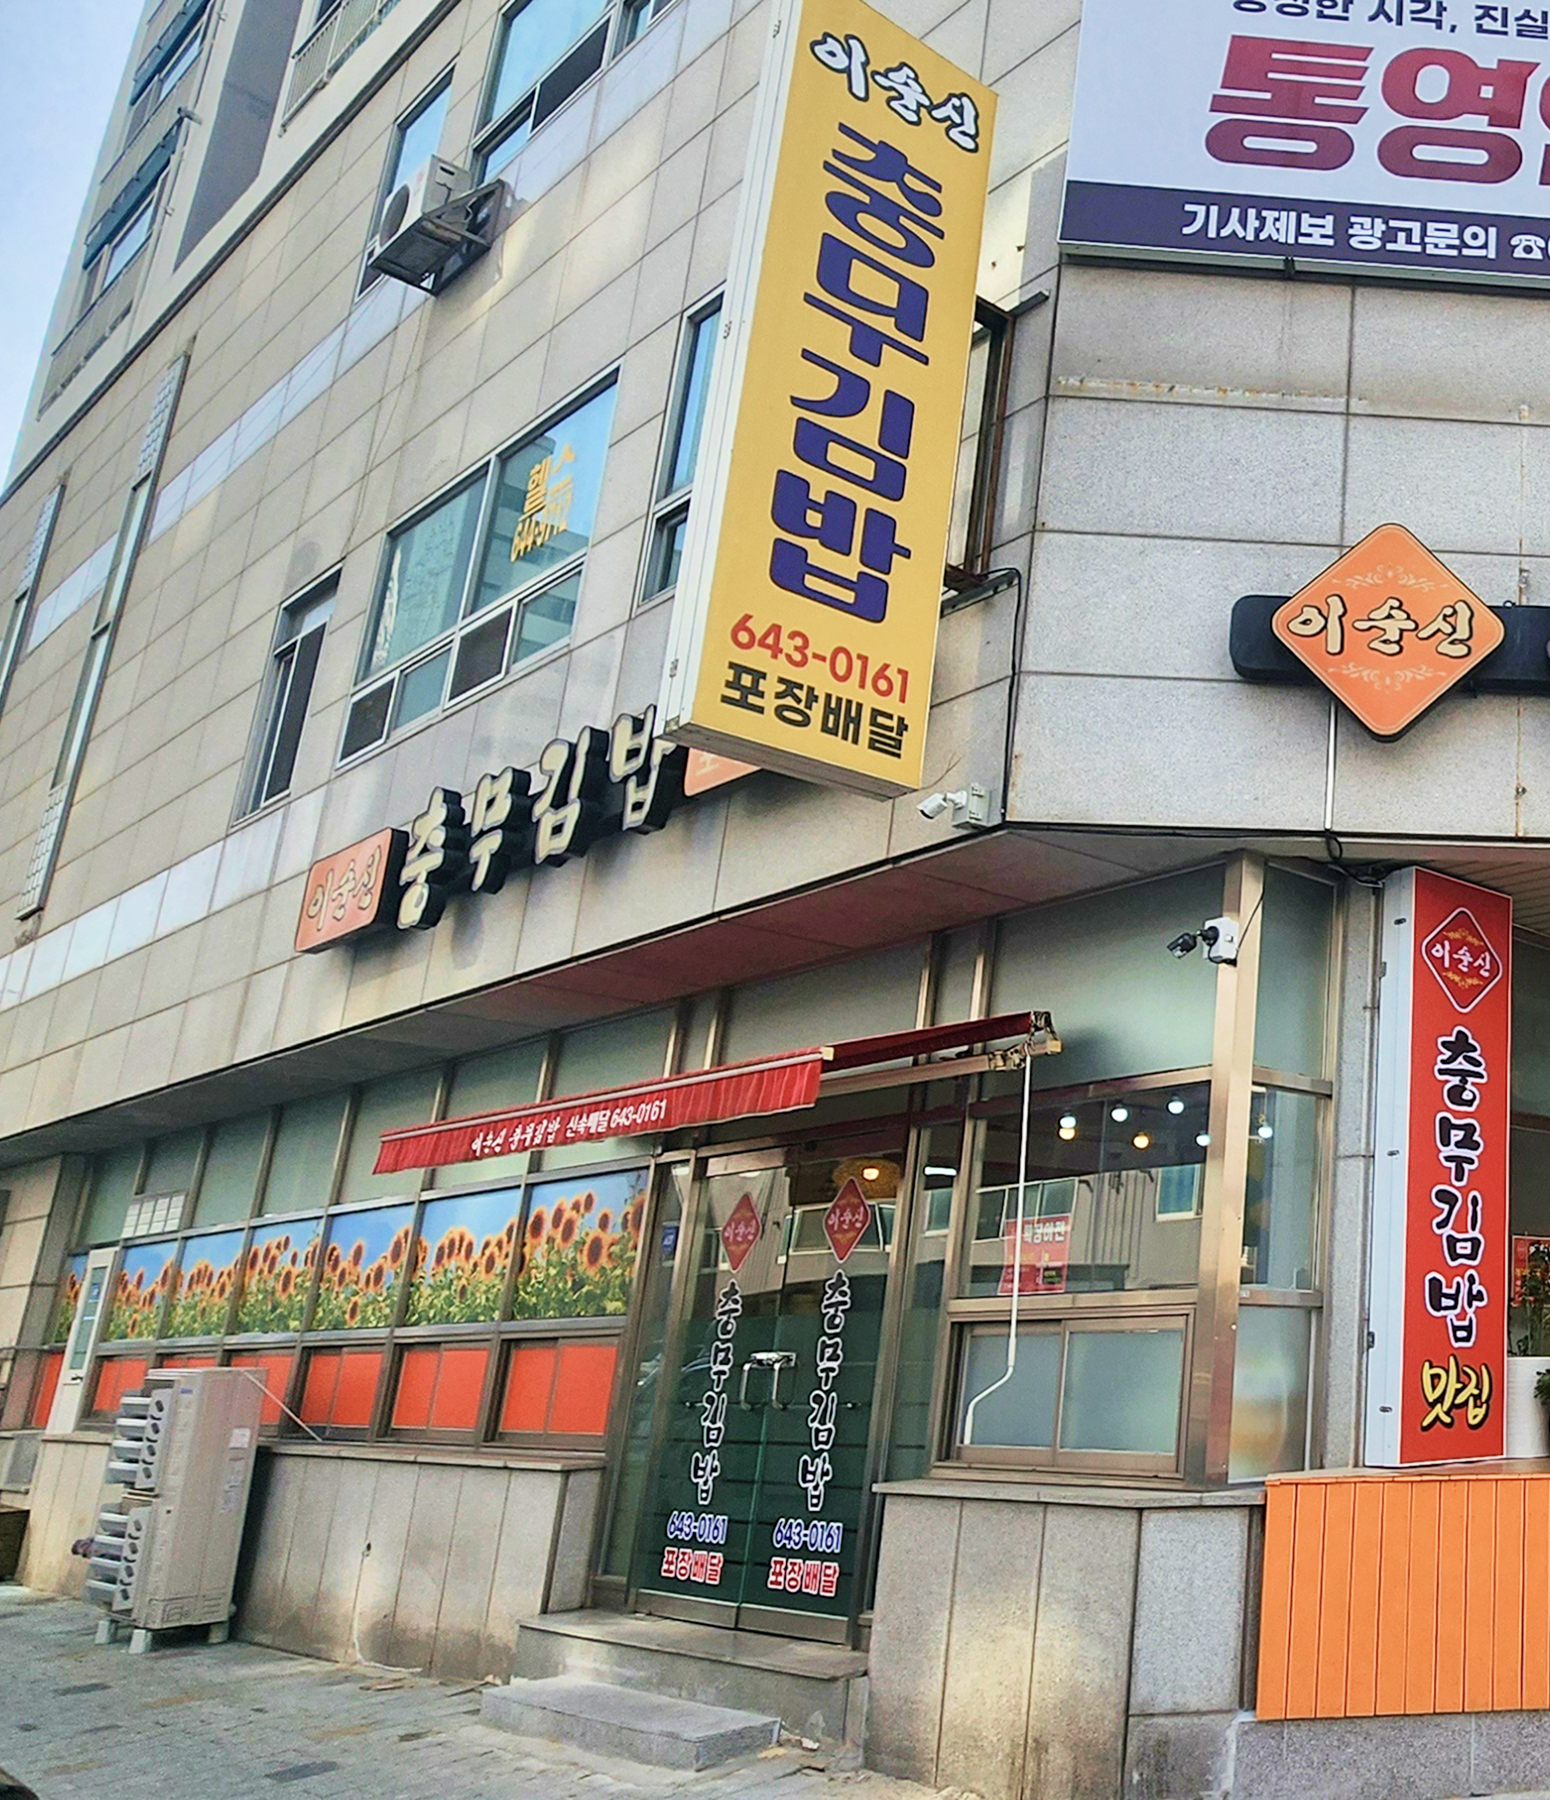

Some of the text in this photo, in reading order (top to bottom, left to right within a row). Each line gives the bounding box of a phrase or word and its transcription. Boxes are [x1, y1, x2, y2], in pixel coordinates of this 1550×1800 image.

[1367, 0, 1458, 34] 시각,
[810, 32, 980, 153] 이순신
[1181, 204, 1336, 247] 기사제보
[1347, 214, 1498, 260] 광고문의
[769, 121, 945, 624] 충무김밥
[1287, 594, 1473, 657] 이순신
[730, 613, 910, 704] 643-0161
[719, 661, 909, 760] 포장배달
[307, 704, 677, 931] 이순신 충무김밥
[1430, 939, 1491, 978] 이순신
[471, 1099, 667, 1157] 이순신 충무김밥 신속배달 643-0161
[1424, 1025, 1488, 1348] 충무김밥
[723, 1220, 756, 1243] 이순신
[828, 1207, 864, 1231] 이순신
[690, 1278, 743, 1505] 충무김밥
[799, 1269, 852, 1512] 충무김밥
[1421, 1353, 1491, 1430] 맛집
[667, 1510, 729, 1545] 643-0161
[773, 1518, 844, 1553] 643-0161
[660, 1547, 724, 1585] 포장배달
[767, 1556, 840, 1597] 포장배달
